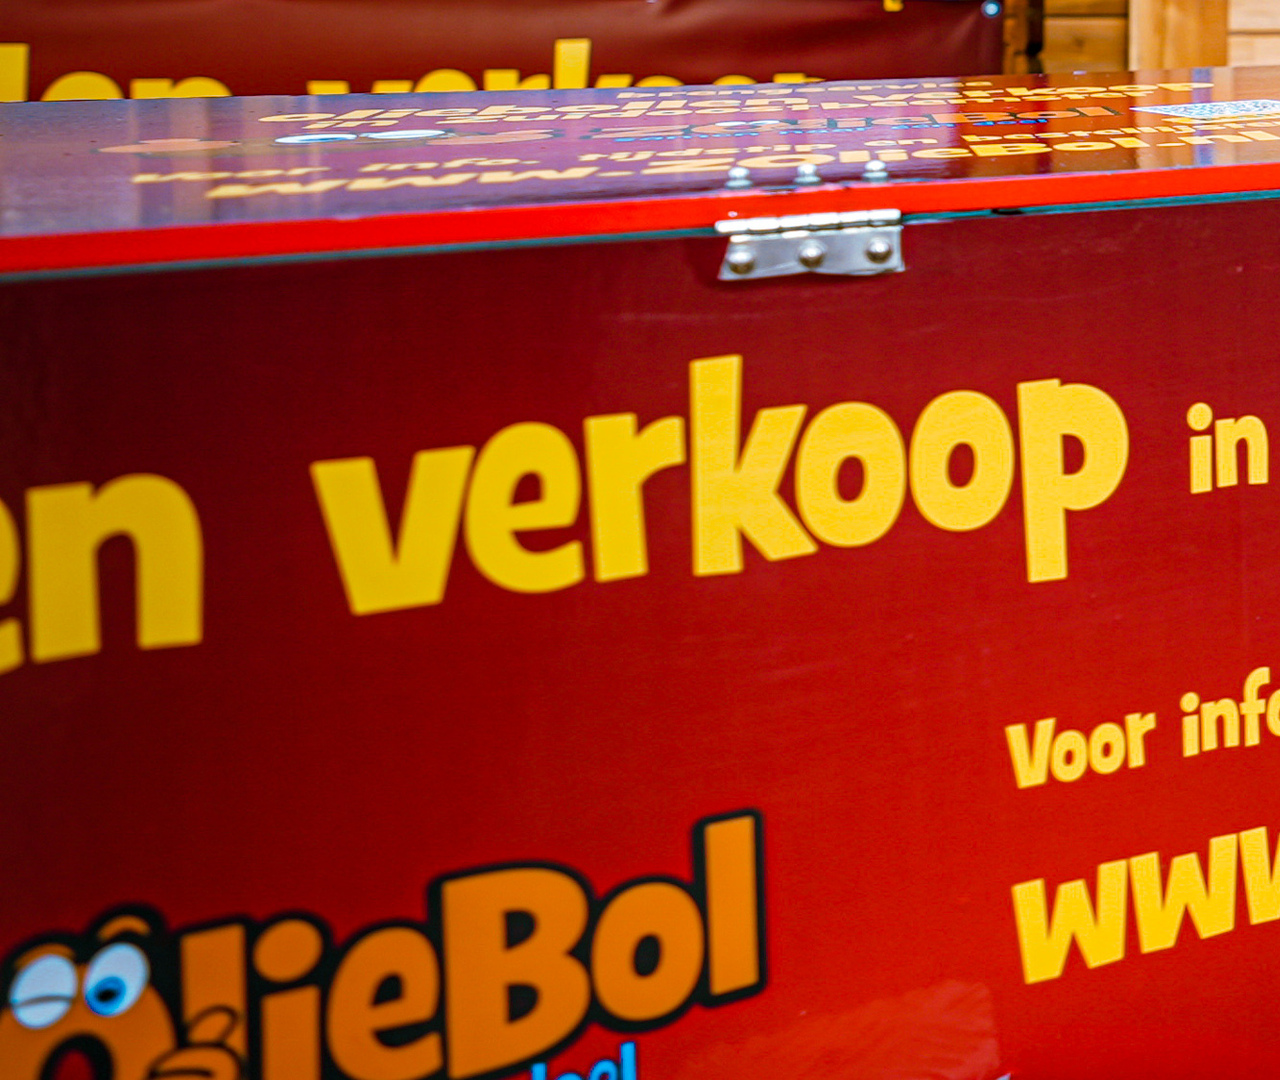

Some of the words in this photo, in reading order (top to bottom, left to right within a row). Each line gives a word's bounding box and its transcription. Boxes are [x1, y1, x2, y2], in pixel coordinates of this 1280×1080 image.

[257, 97, 809, 122] oliebollen
[854, 83, 1214, 101] verkoop
[302, 120, 399, 129] in
[132, 167, 330, 184] Voor
[578, 144, 837, 162] tijdstip
[863, 138, 938, 147] en
[309, 354, 1129, 616] verkoop
[1189, 401, 1269, 494] in
[1006, 712, 1156, 788] Voor
